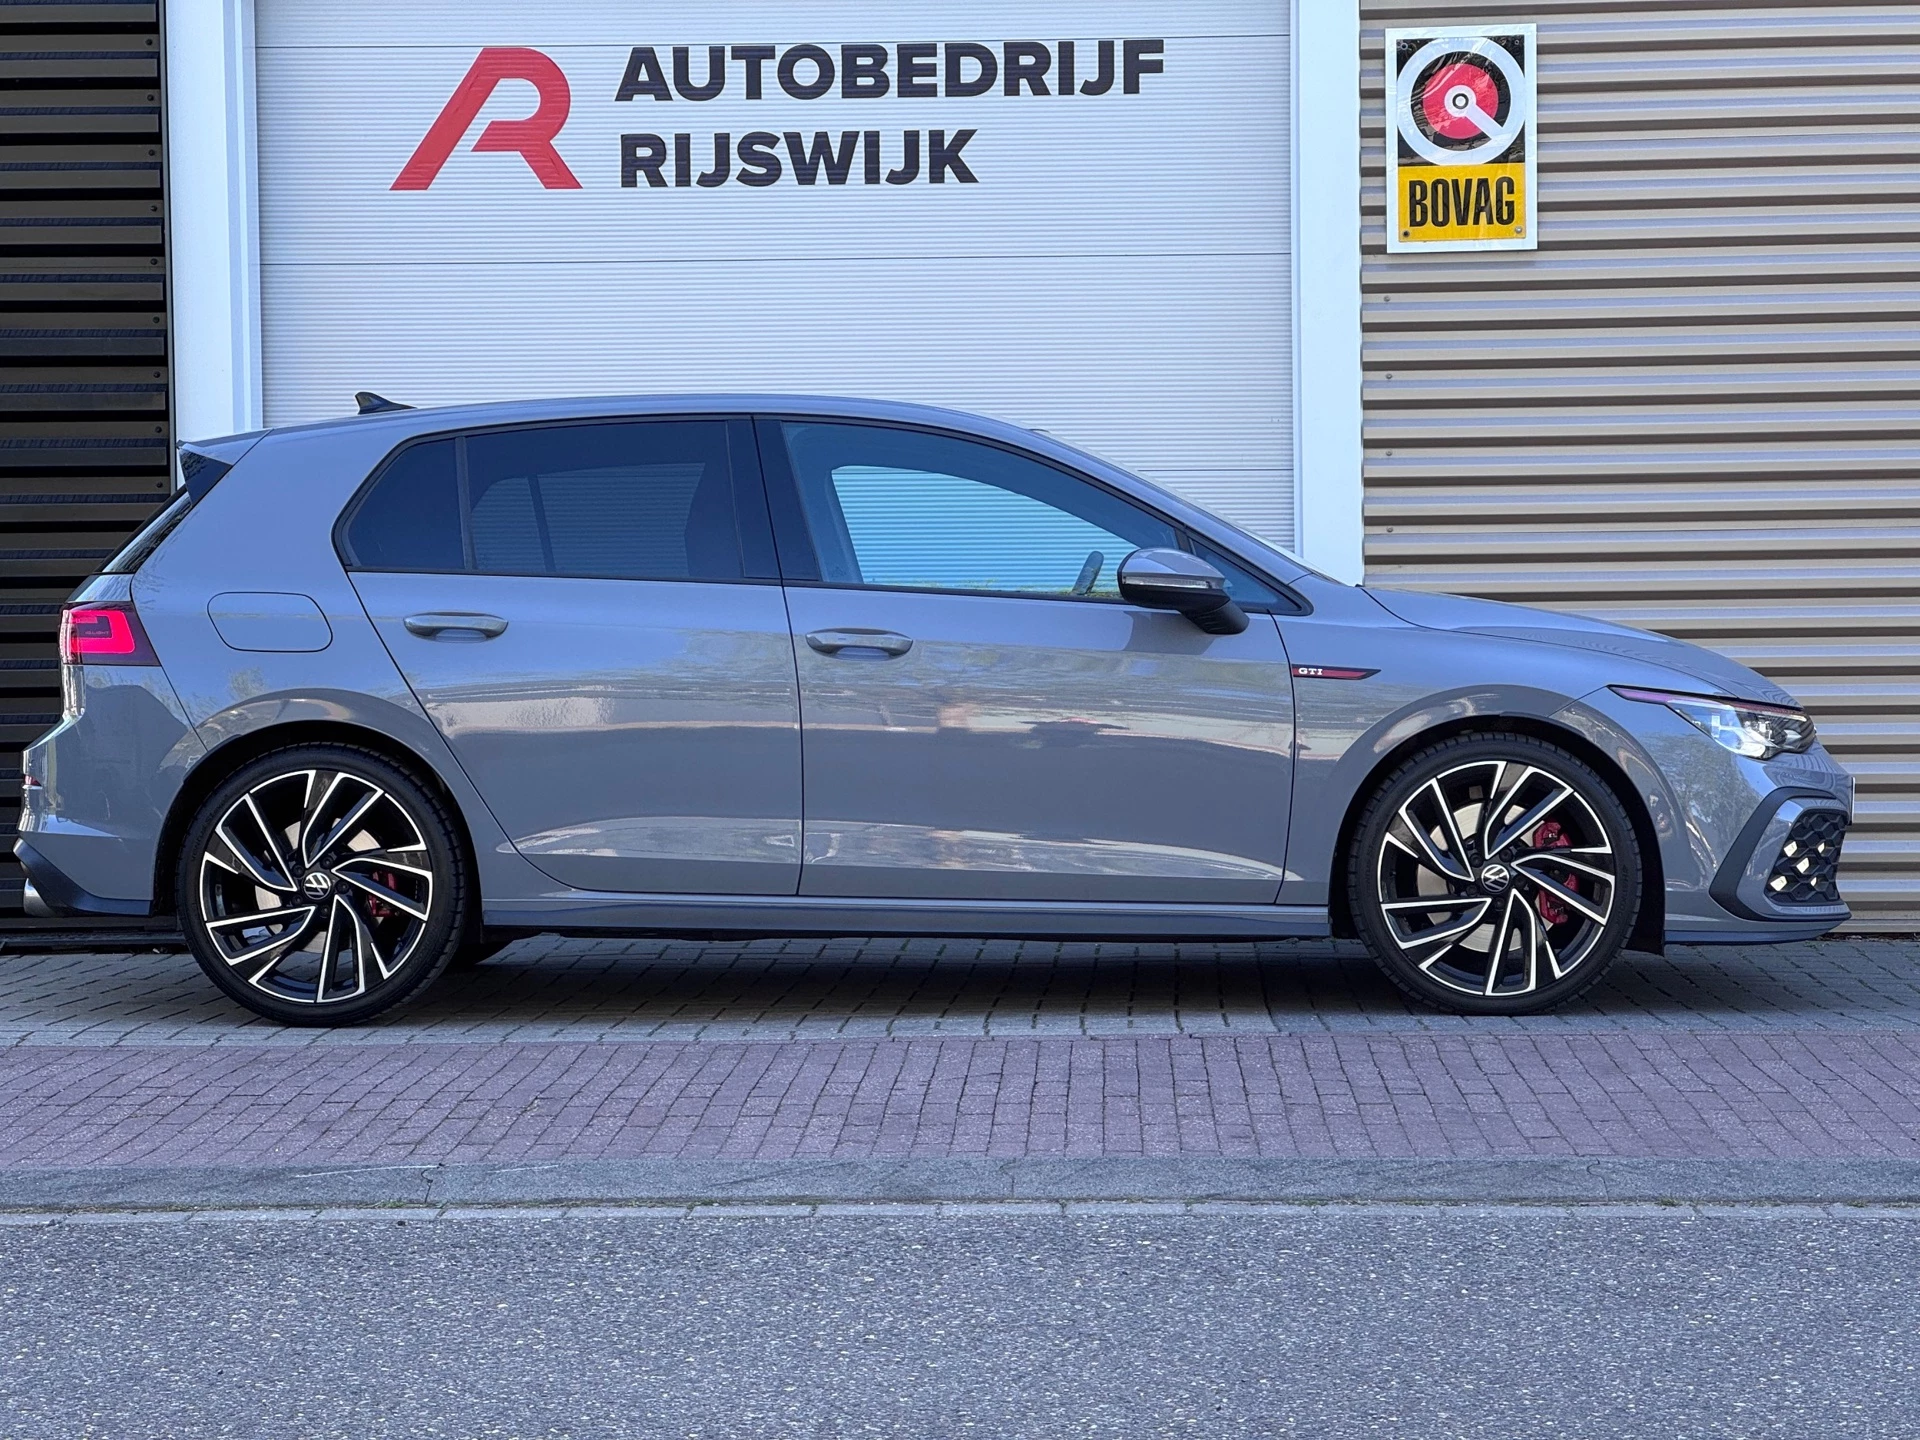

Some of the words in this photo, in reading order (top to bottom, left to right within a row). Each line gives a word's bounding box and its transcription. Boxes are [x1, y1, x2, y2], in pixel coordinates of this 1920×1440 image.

[616, 39, 1164, 101] AUTOBEDRIJF
[621, 128, 979, 188] RIJSWIJK
[1409, 176, 1515, 227] BOVAG
[1298, 667, 1323, 675] GTI
